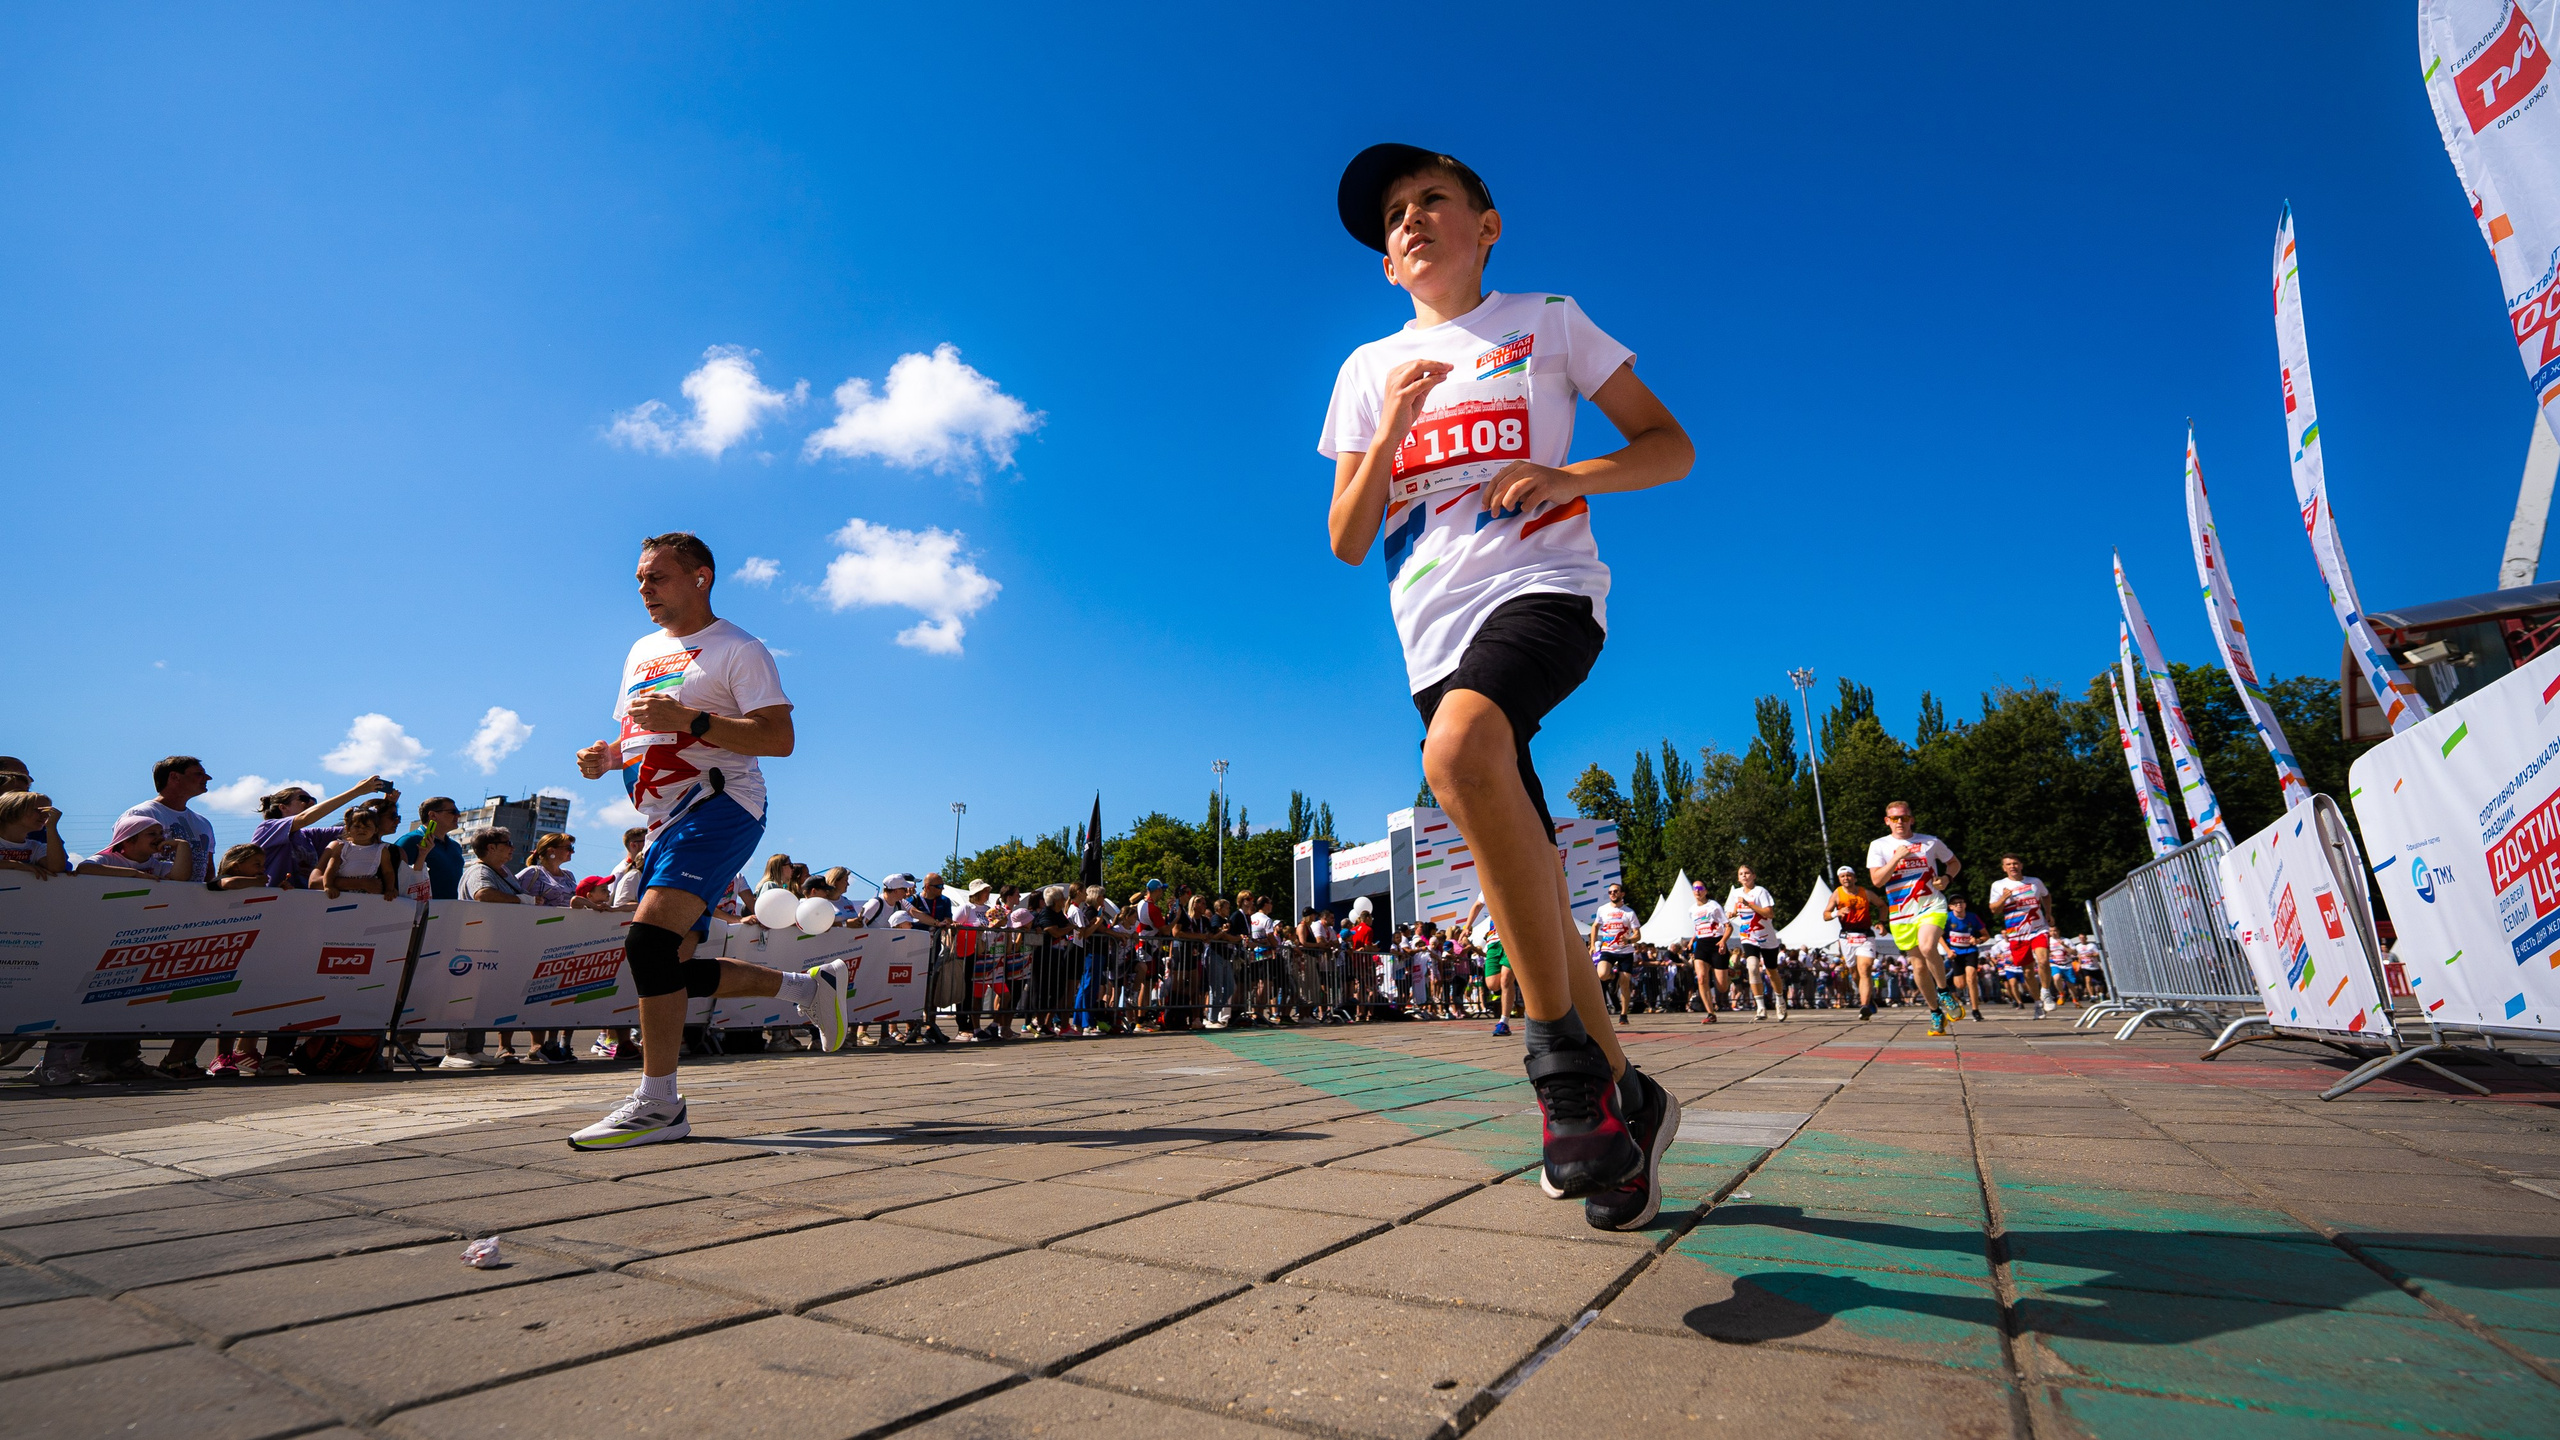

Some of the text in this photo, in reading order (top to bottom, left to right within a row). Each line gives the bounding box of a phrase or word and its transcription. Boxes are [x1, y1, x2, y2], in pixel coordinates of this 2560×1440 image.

[2451, 12, 2507, 72] ГЕНЕРАЛЬНЫЙ
[2497, 84, 2549, 129] ОАО «РЖД»
[1480, 337, 1531, 367] ДОСТИГАЯ
[1496, 345, 1531, 367] ЦЕЛИ!
[1423, 418, 1523, 464] 1108
[637, 651, 696, 674] ДОСТИГАЯ
[649, 661, 687, 678] ЦЕЛИ!
[2482, 804, 2516, 846] ПРАЗДНИК
[1905, 859, 1927, 869] 2241
[2499, 884, 2525, 915] ДЛЯ ВСЕЙ
[116, 913, 263, 938] СПОРТИВНО-МУЗЫКАЛЬНЫЙ
[2503, 902, 2530, 933] СЕМЬИ
[105, 933, 249, 969] ДОСТИГАЯ
[110, 933, 169, 946] ПРАЗДНИК
[544, 935, 626, 955] СПОРТИВНО-МУЗЫКАЛЬНЫ
[2515, 947, 2520, 957] В
[2519, 937, 2536, 953] ЧЕСТЬ
[2535, 928, 2548, 945] ДНЯ
[149, 951, 239, 979] ЦЕЛИ!
[538, 949, 623, 978] ДОСТИГАЯ
[541, 950, 576, 961] ПРАЗДНИК
[88, 975, 134, 989] СЕМЬИ
[93, 967, 138, 979] ДЛЯ ВСЕЙ
[564, 962, 617, 986] ЦЕЛИ!
[88, 973, 232, 1000] В ЧЕСТЬ ДНЯ ЖЕЛЕЗНОДОРОЖНИКА
[528, 983, 556, 993] СЕМЬИ
